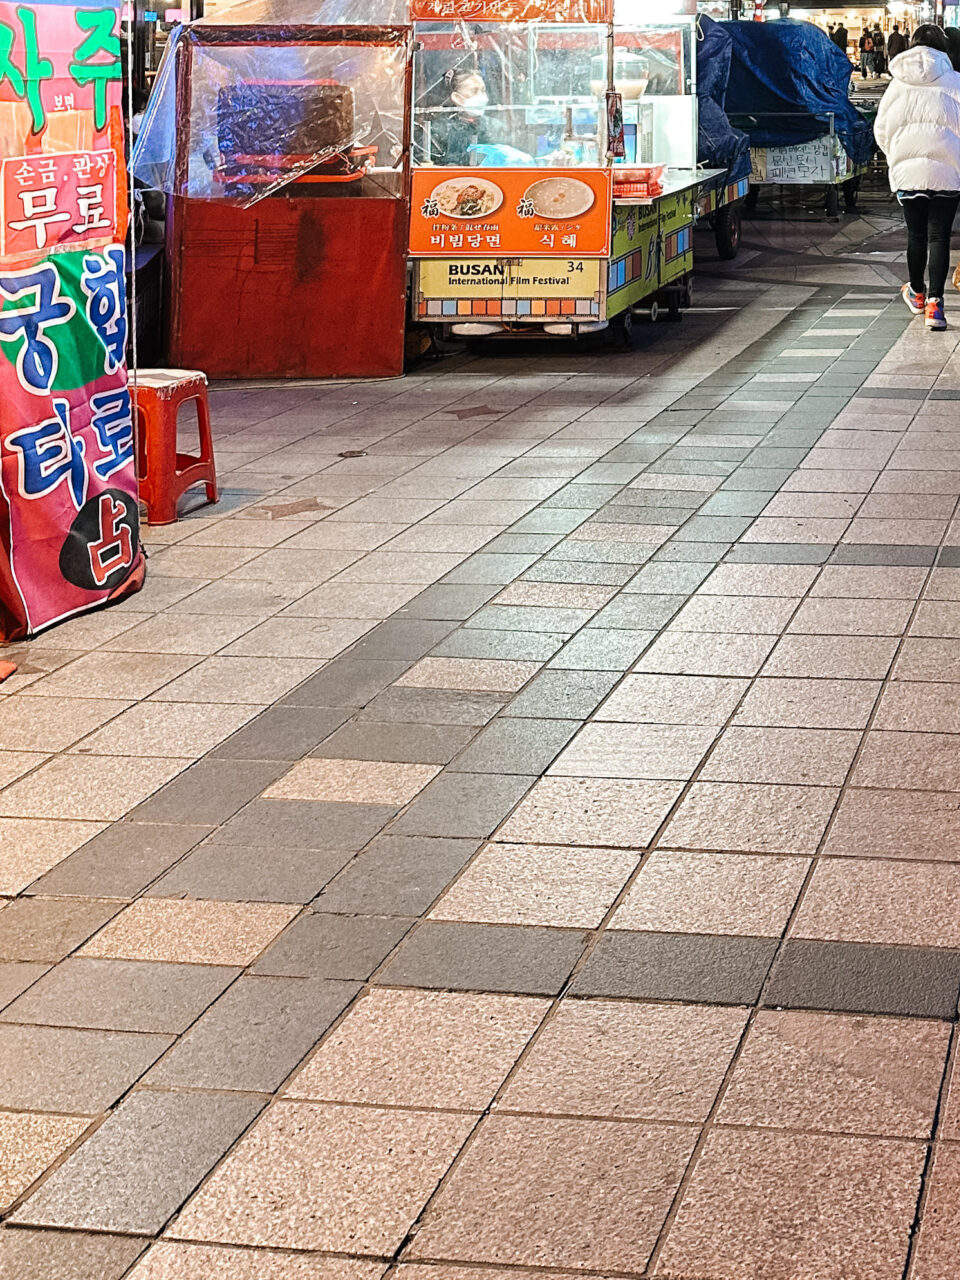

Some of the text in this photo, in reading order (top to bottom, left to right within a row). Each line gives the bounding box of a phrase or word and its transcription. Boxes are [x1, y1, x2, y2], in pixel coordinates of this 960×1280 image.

[0, 6, 121, 136] 사주
[53, 93, 75, 111] 보면
[8, 184, 113, 249] 무료
[421, 198, 440, 218] 福
[516, 198, 535, 218] 福
[430, 233, 501, 248] 비빔당면
[539, 233, 577, 249] 식혜
[448, 261, 584, 276] BUSAN 34
[448, 276, 570, 285] International Film Festival
[0, 243, 127, 396] 궁합
[5, 387, 135, 511] 타로
